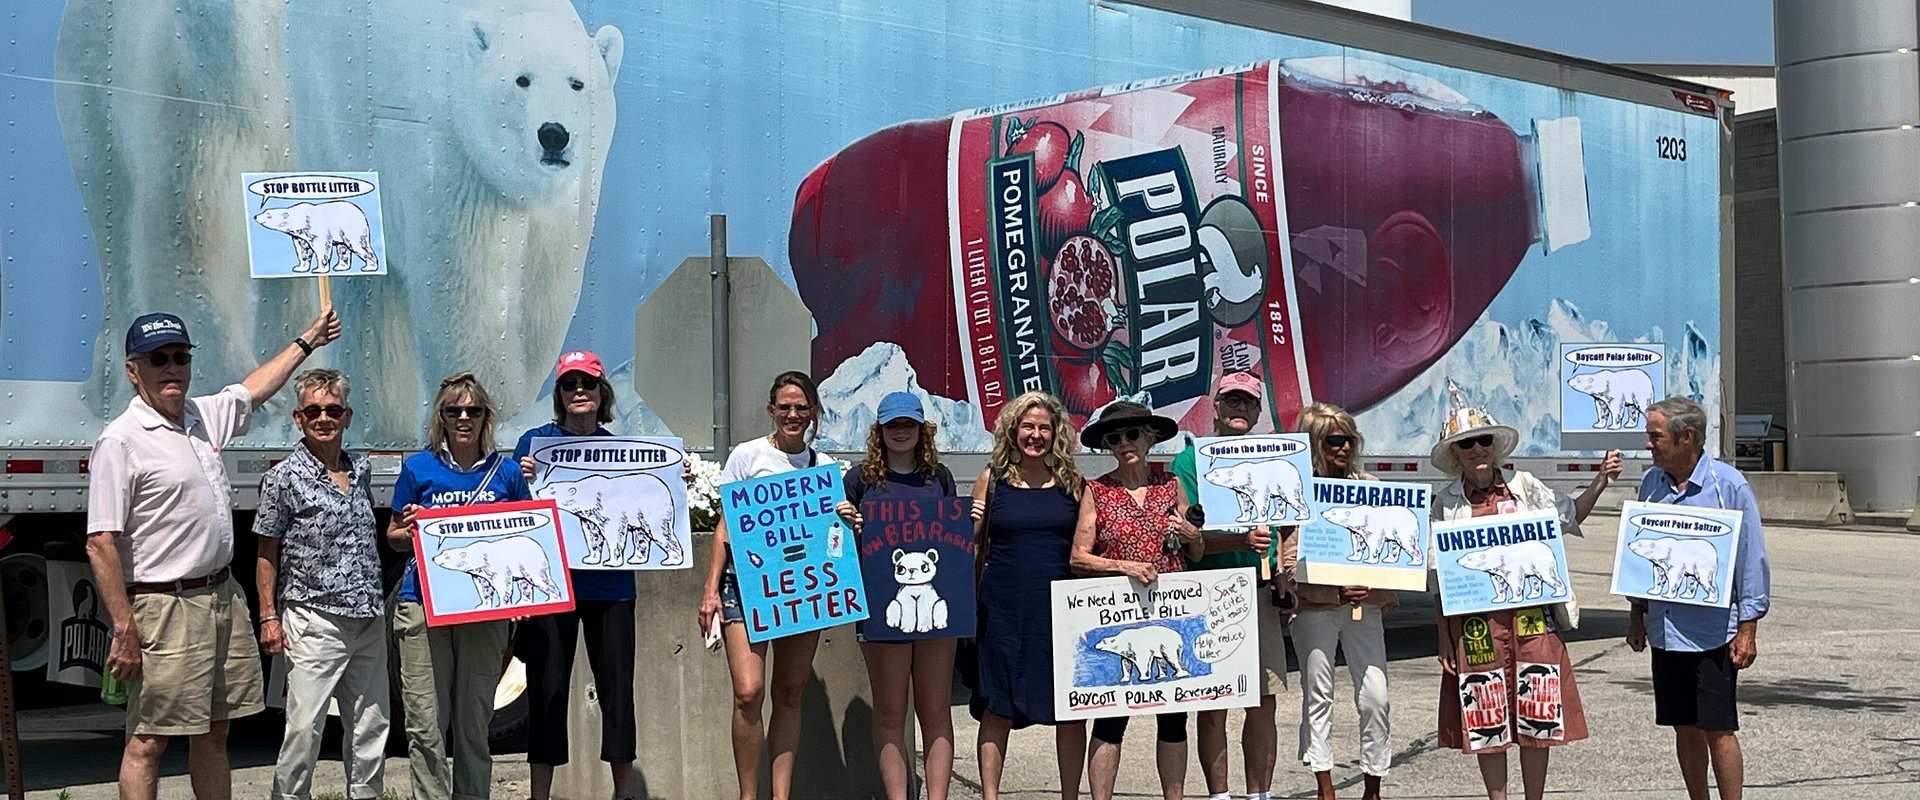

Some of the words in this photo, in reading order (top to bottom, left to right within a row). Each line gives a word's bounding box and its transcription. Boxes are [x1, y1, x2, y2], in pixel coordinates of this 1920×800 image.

[1212, 126, 1228, 184] NATURALLY
[1656, 136, 1686, 161] 1203
[263, 183, 289, 193] STOP
[292, 182, 327, 193] BOTTLE
[329, 182, 360, 193] LITTER
[967, 237, 983, 245] 1
[1252, 144, 1268, 203] SINCE
[1268, 300, 1285, 345] 1882
[968, 249, 986, 287] LITER
[1116, 170, 1200, 388] POLAR
[1002, 168, 1043, 396] POMEGRANATE
[974, 308, 991, 332] QT.
[977, 333, 995, 355] 1.8
[1576, 352, 1604, 362] Boycott
[1606, 353, 1625, 361] Polar
[981, 358, 997, 379] FL.
[550, 449, 582, 462] STOP
[584, 449, 627, 462] BOTTLE
[629, 449, 667, 462] LITTER
[1210, 445, 1239, 455] Update
[1241, 444, 1255, 454] the
[1256, 444, 1281, 453] Bottle
[1282, 443, 1296, 451] Bill
[731, 471, 833, 508] MODERN
[739, 496, 834, 533] BOTTLE
[864, 499, 921, 521] THIS
[938, 499, 963, 520] IS
[439, 522, 464, 535] STOP
[466, 519, 501, 532] BOTTLE
[503, 516, 535, 529] LITTER
[1641, 517, 1671, 528] Boycott
[1672, 520, 1692, 530] Polar
[765, 524, 813, 548] BILL
[1436, 520, 1557, 552] UNBEARABLE
[762, 562, 838, 598] LESS
[1066, 594, 1084, 610] We
[1087, 590, 1116, 608] Need
[1123, 592, 1141, 604] an
[1147, 582, 1202, 606] Improved
[1213, 583, 1238, 602] Save
[752, 588, 862, 632] LITTER
[1100, 606, 1151, 625] BOTTLE
[1159, 604, 1190, 618] BILL
[1209, 605, 1221, 617] for
[1210, 615, 1225, 629] and
[63, 623, 105, 667] POLAR
[1218, 632, 1245, 643] reduce
[1468, 639, 1489, 651] TELL
[1467, 652, 1495, 664] TRUTH
[1069, 690, 1116, 708] BOYCOTT
[1125, 690, 1167, 705] POLAR
[1174, 683, 1233, 701] Beverages
